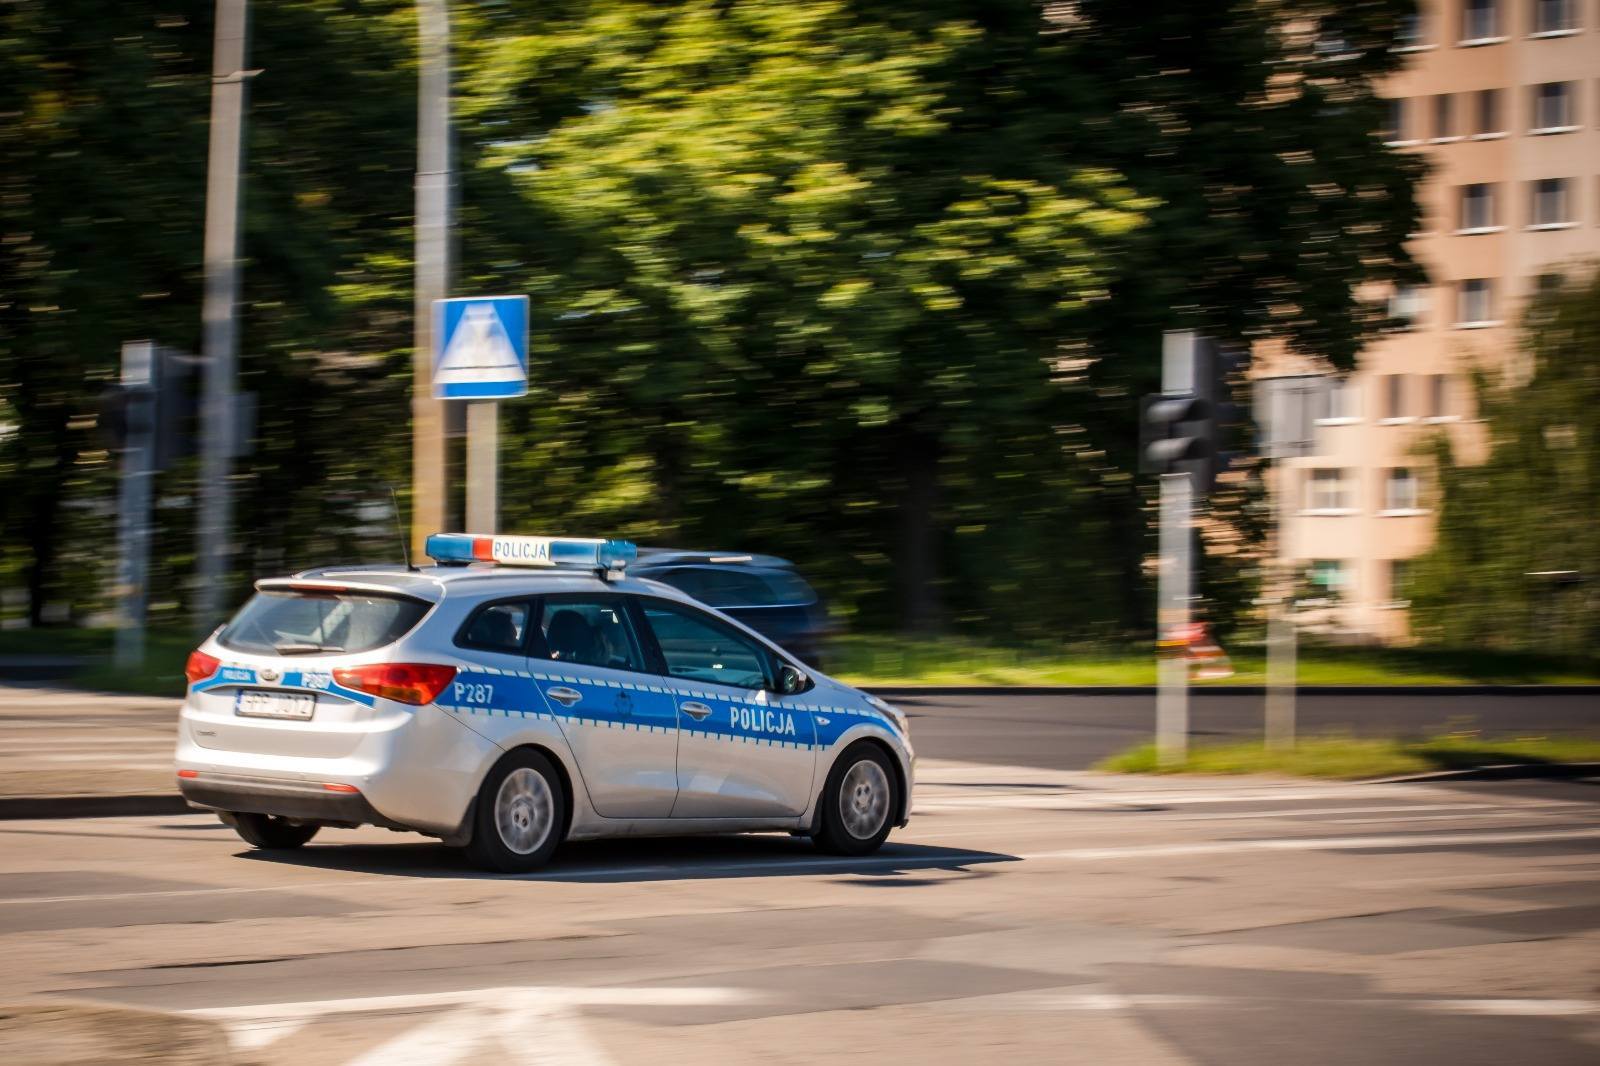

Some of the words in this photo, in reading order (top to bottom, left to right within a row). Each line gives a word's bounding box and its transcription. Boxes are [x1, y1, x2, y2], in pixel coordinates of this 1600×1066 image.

[494, 542, 547, 559] POLICJA
[454, 681, 494, 704] P287
[730, 706, 796, 736] POLICJA
